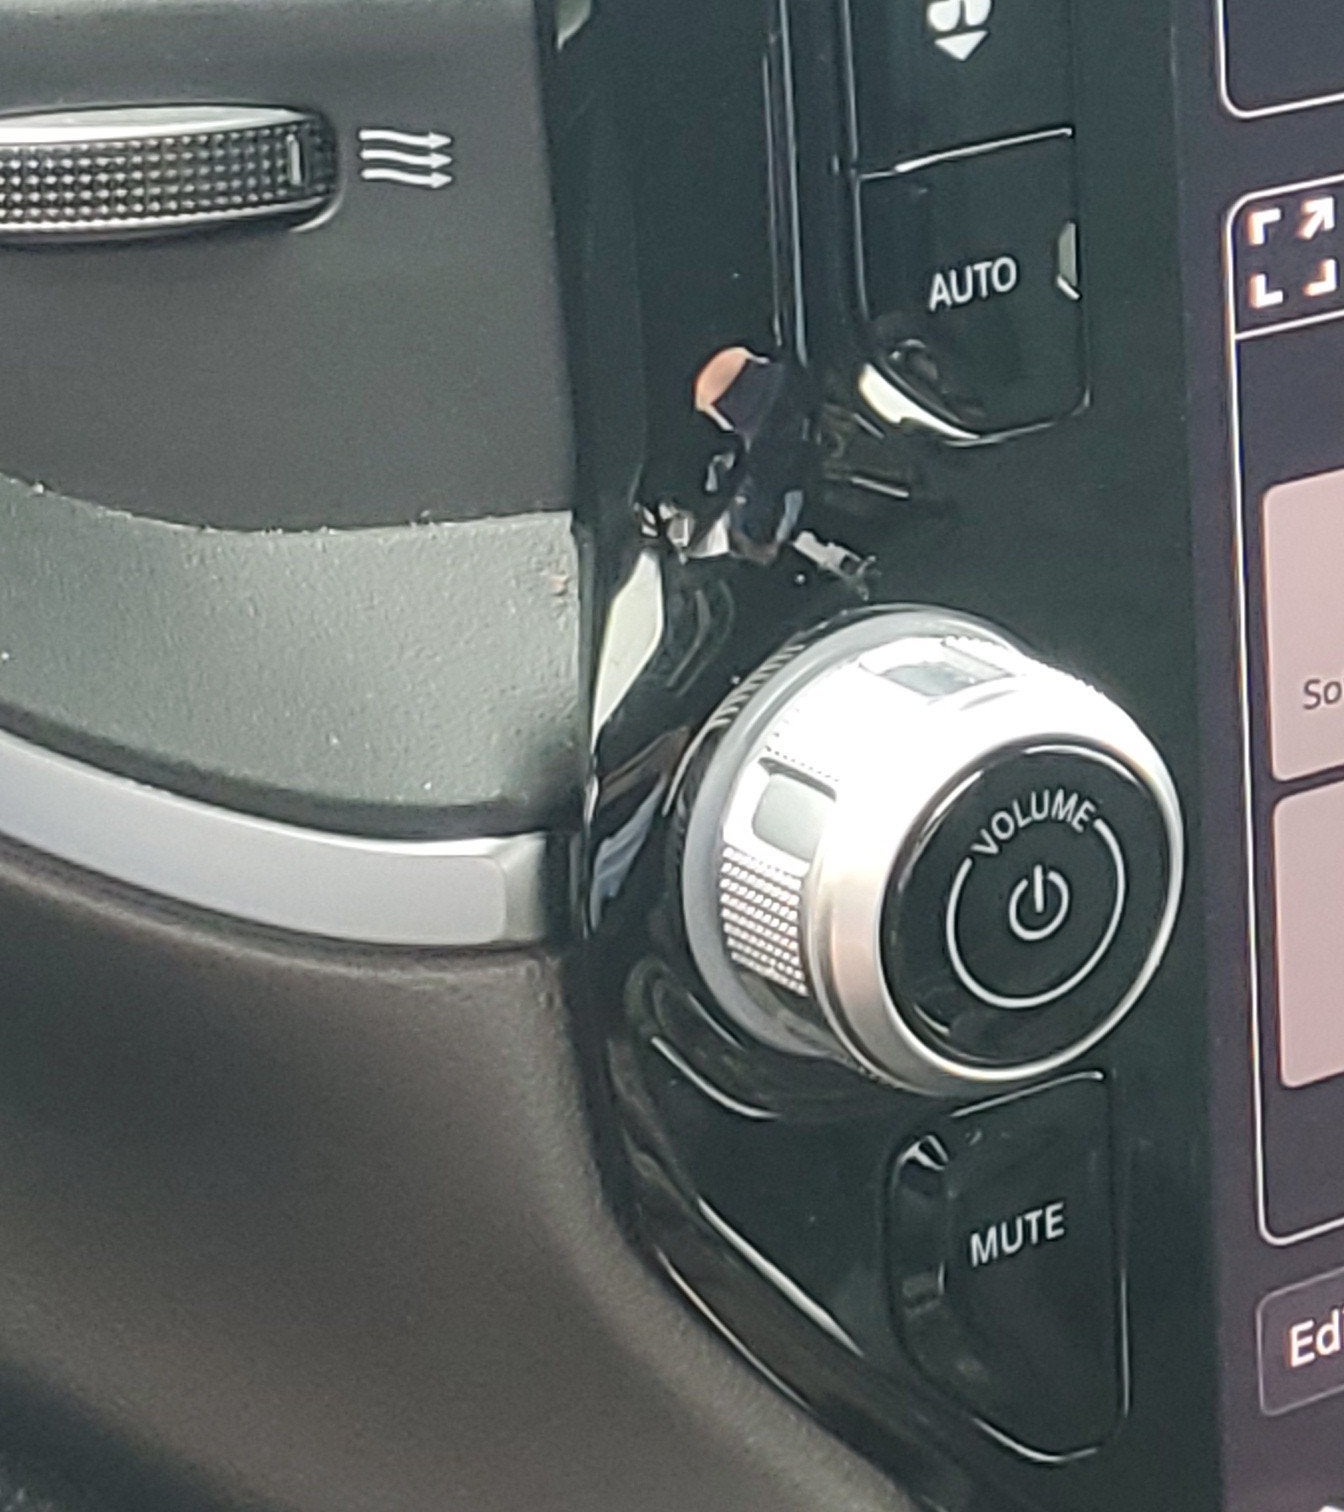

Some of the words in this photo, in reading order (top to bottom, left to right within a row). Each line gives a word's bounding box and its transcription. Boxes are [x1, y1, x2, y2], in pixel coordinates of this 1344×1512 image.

[929, 256, 1018, 312] AUTO
[970, 788, 1097, 856] VOLUME
[969, 1201, 1066, 1268] MUTE
